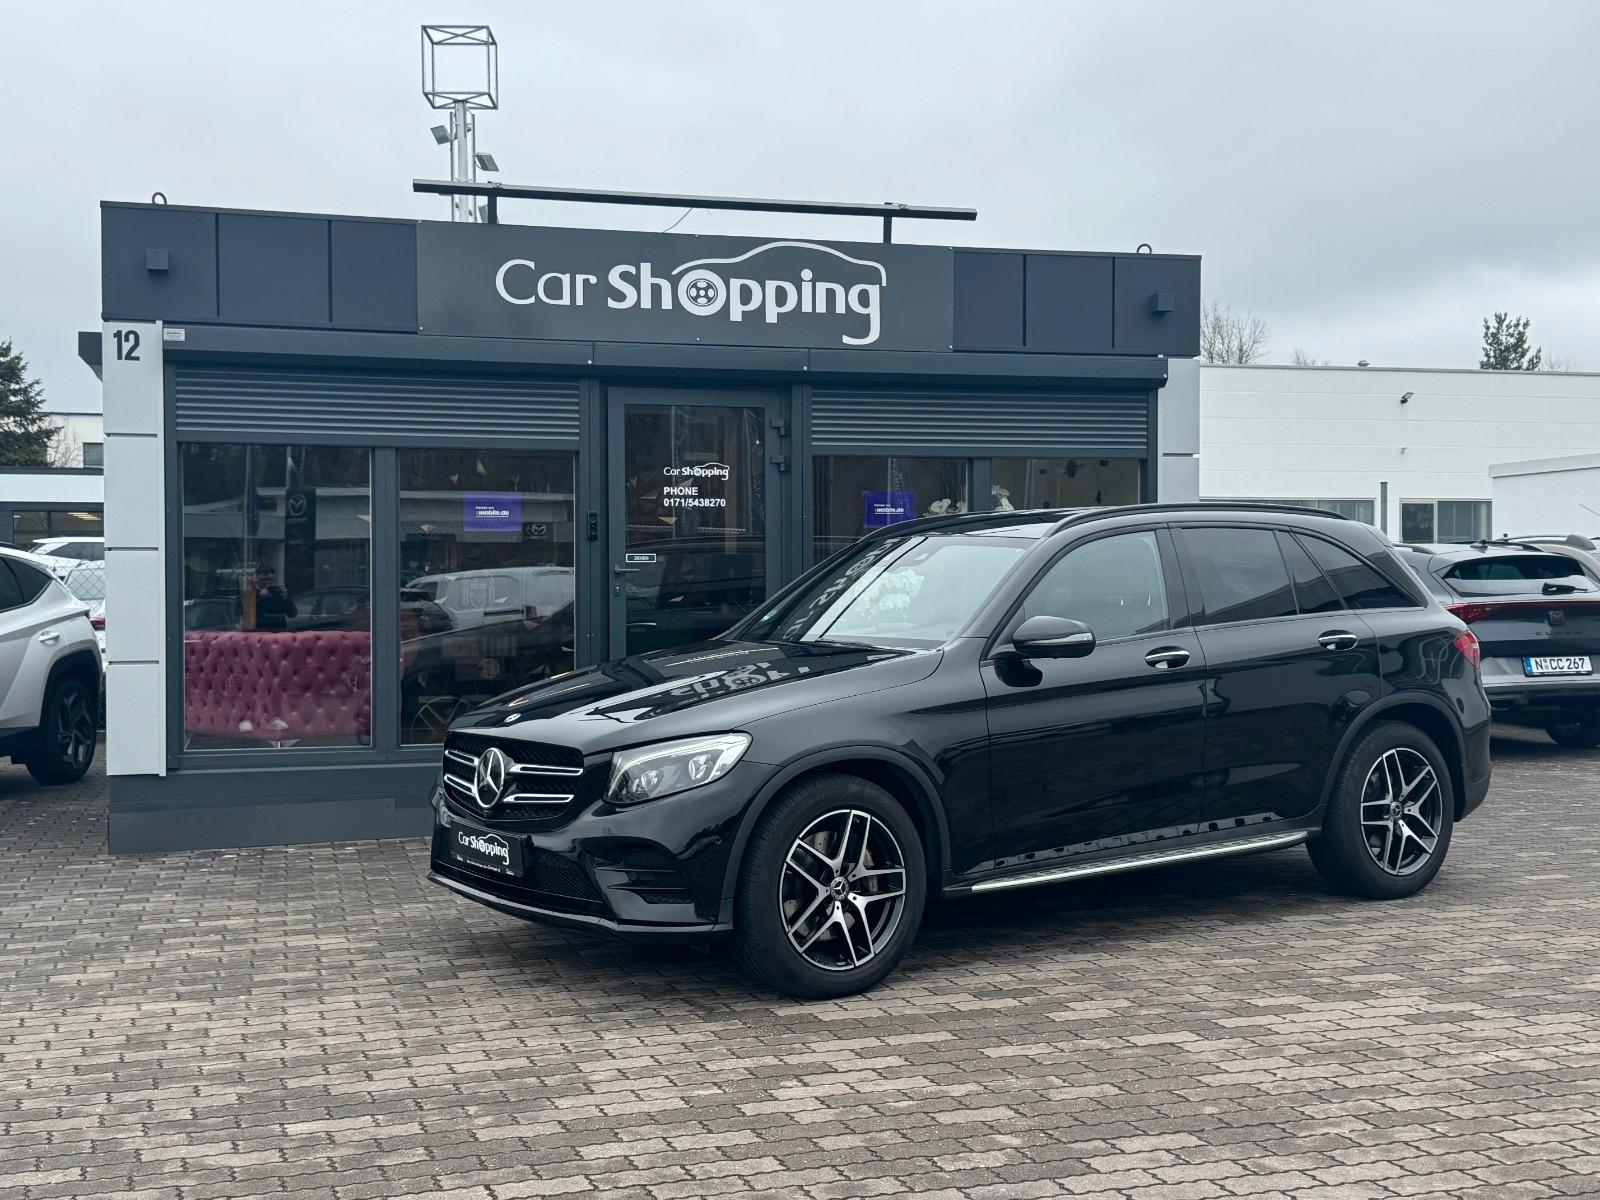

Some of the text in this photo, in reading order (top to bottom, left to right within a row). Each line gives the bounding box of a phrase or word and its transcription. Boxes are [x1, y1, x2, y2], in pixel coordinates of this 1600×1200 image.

[495, 258, 881, 345] Car Shopping
[113, 329, 141, 361] 12
[663, 467, 729, 481] Car Shopping
[663, 486, 699, 496] PHONE
[663, 498, 726, 507] 0171/5438270
[1534, 657, 1585, 670] N CC 267
[458, 831, 470, 846] Car
[470, 836, 510, 865] Shopping
